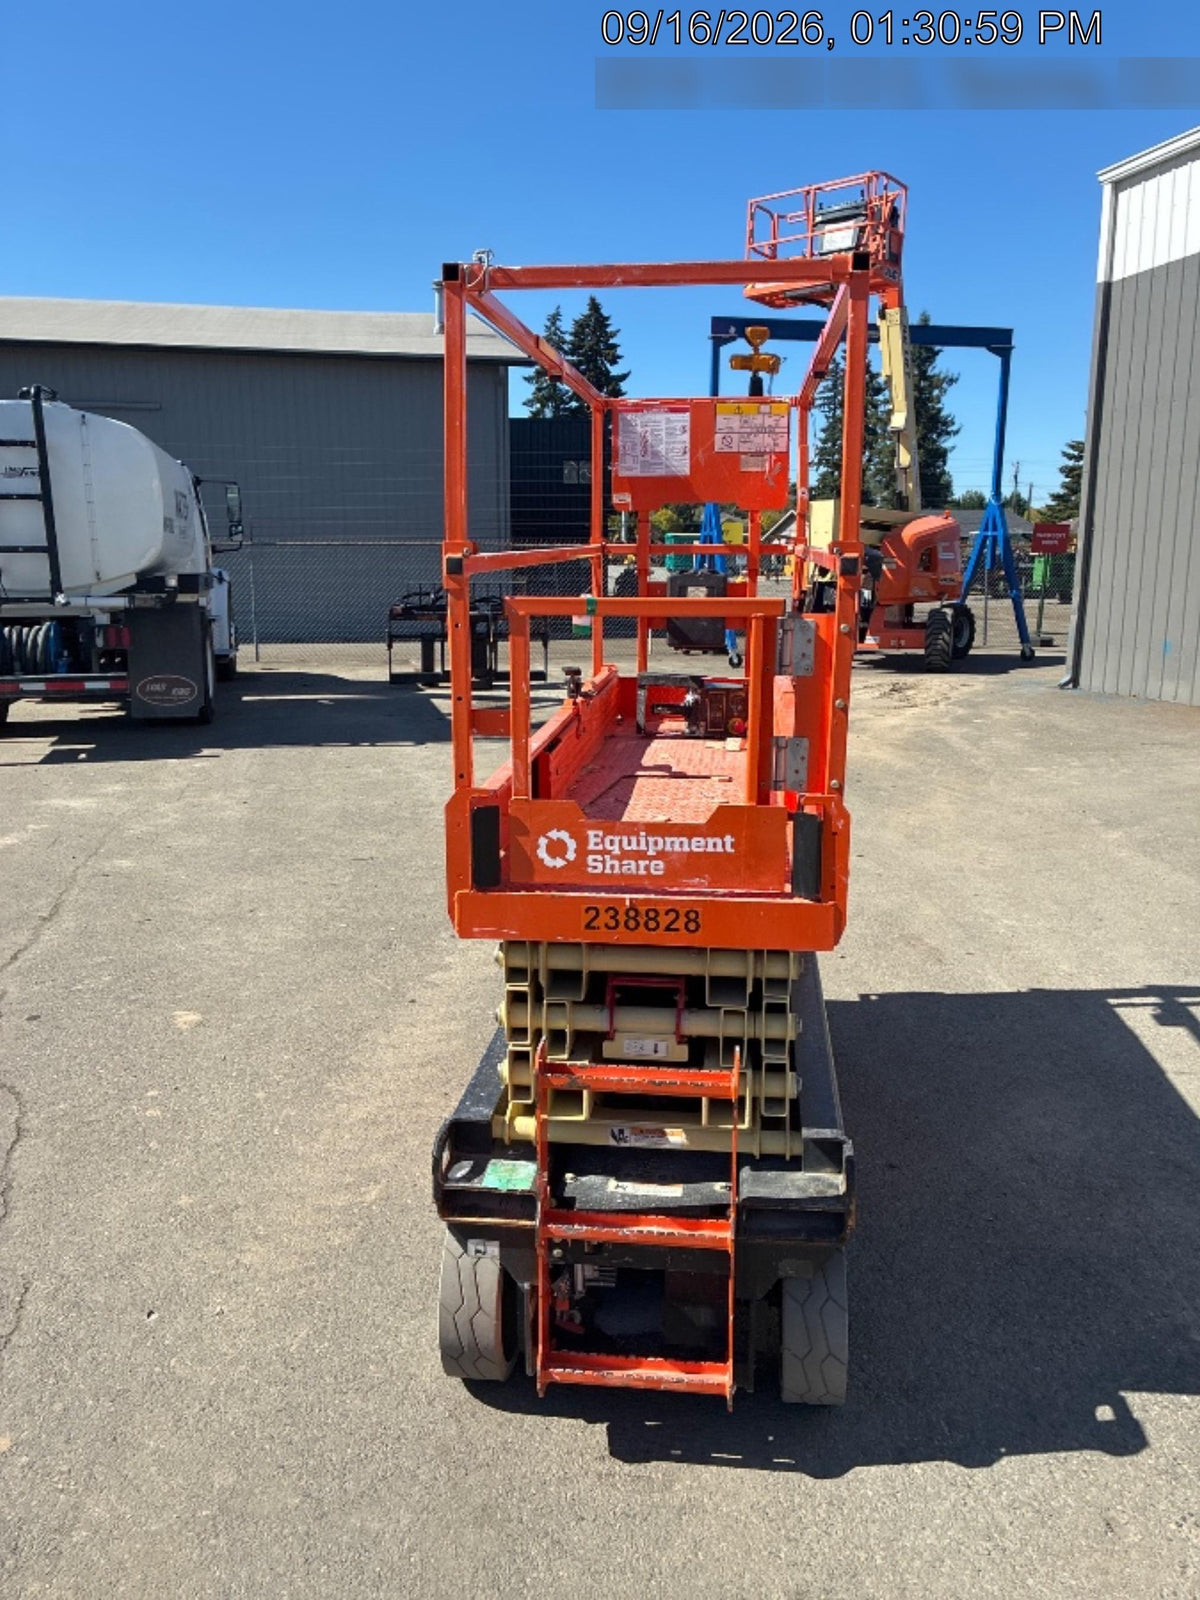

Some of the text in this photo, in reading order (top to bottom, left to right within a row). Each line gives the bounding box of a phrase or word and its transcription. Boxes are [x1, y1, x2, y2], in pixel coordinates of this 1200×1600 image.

[586, 830, 735, 856] Equipment
[586, 854, 665, 875] Share
[584, 906, 701, 934] 238828
